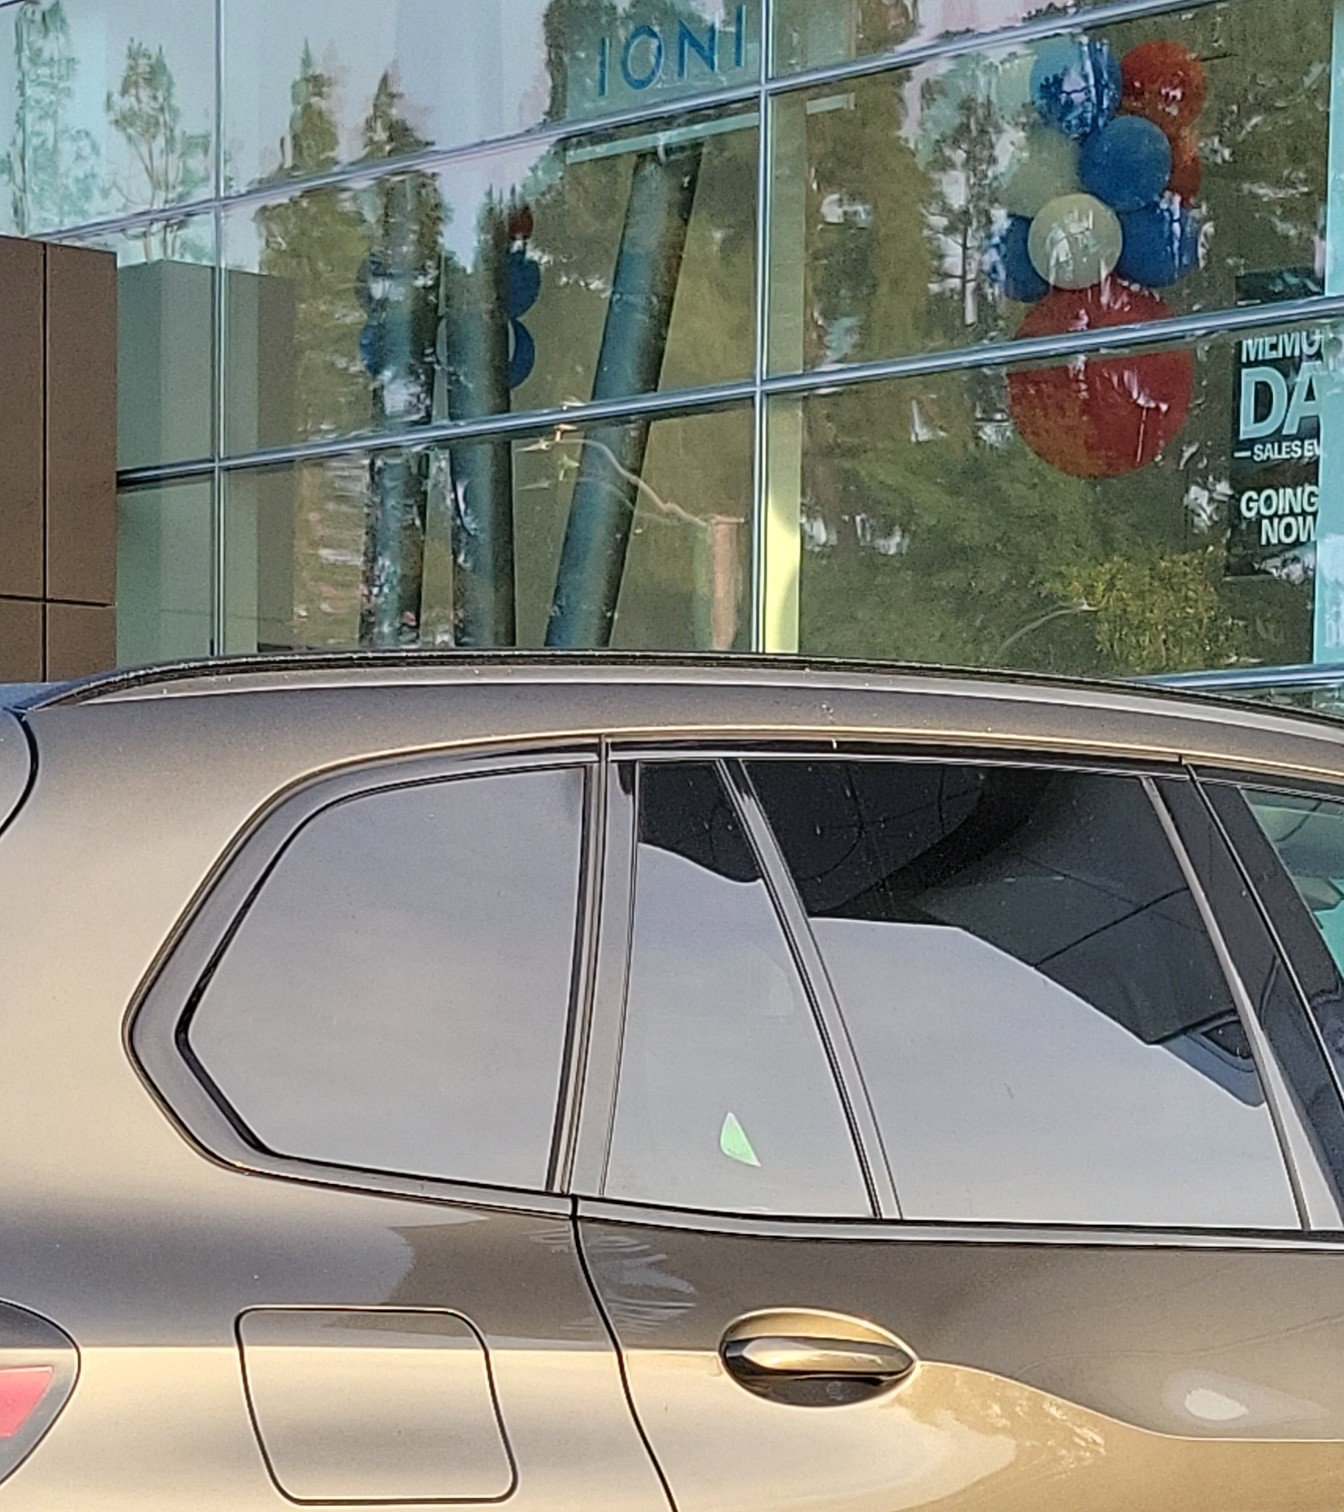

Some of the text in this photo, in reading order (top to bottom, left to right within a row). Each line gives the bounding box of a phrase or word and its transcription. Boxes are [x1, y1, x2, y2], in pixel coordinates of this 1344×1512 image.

[1253, 441, 1302, 462] SALES
[1240, 486, 1320, 519] GOING
[1261, 515, 1317, 546] NOW
